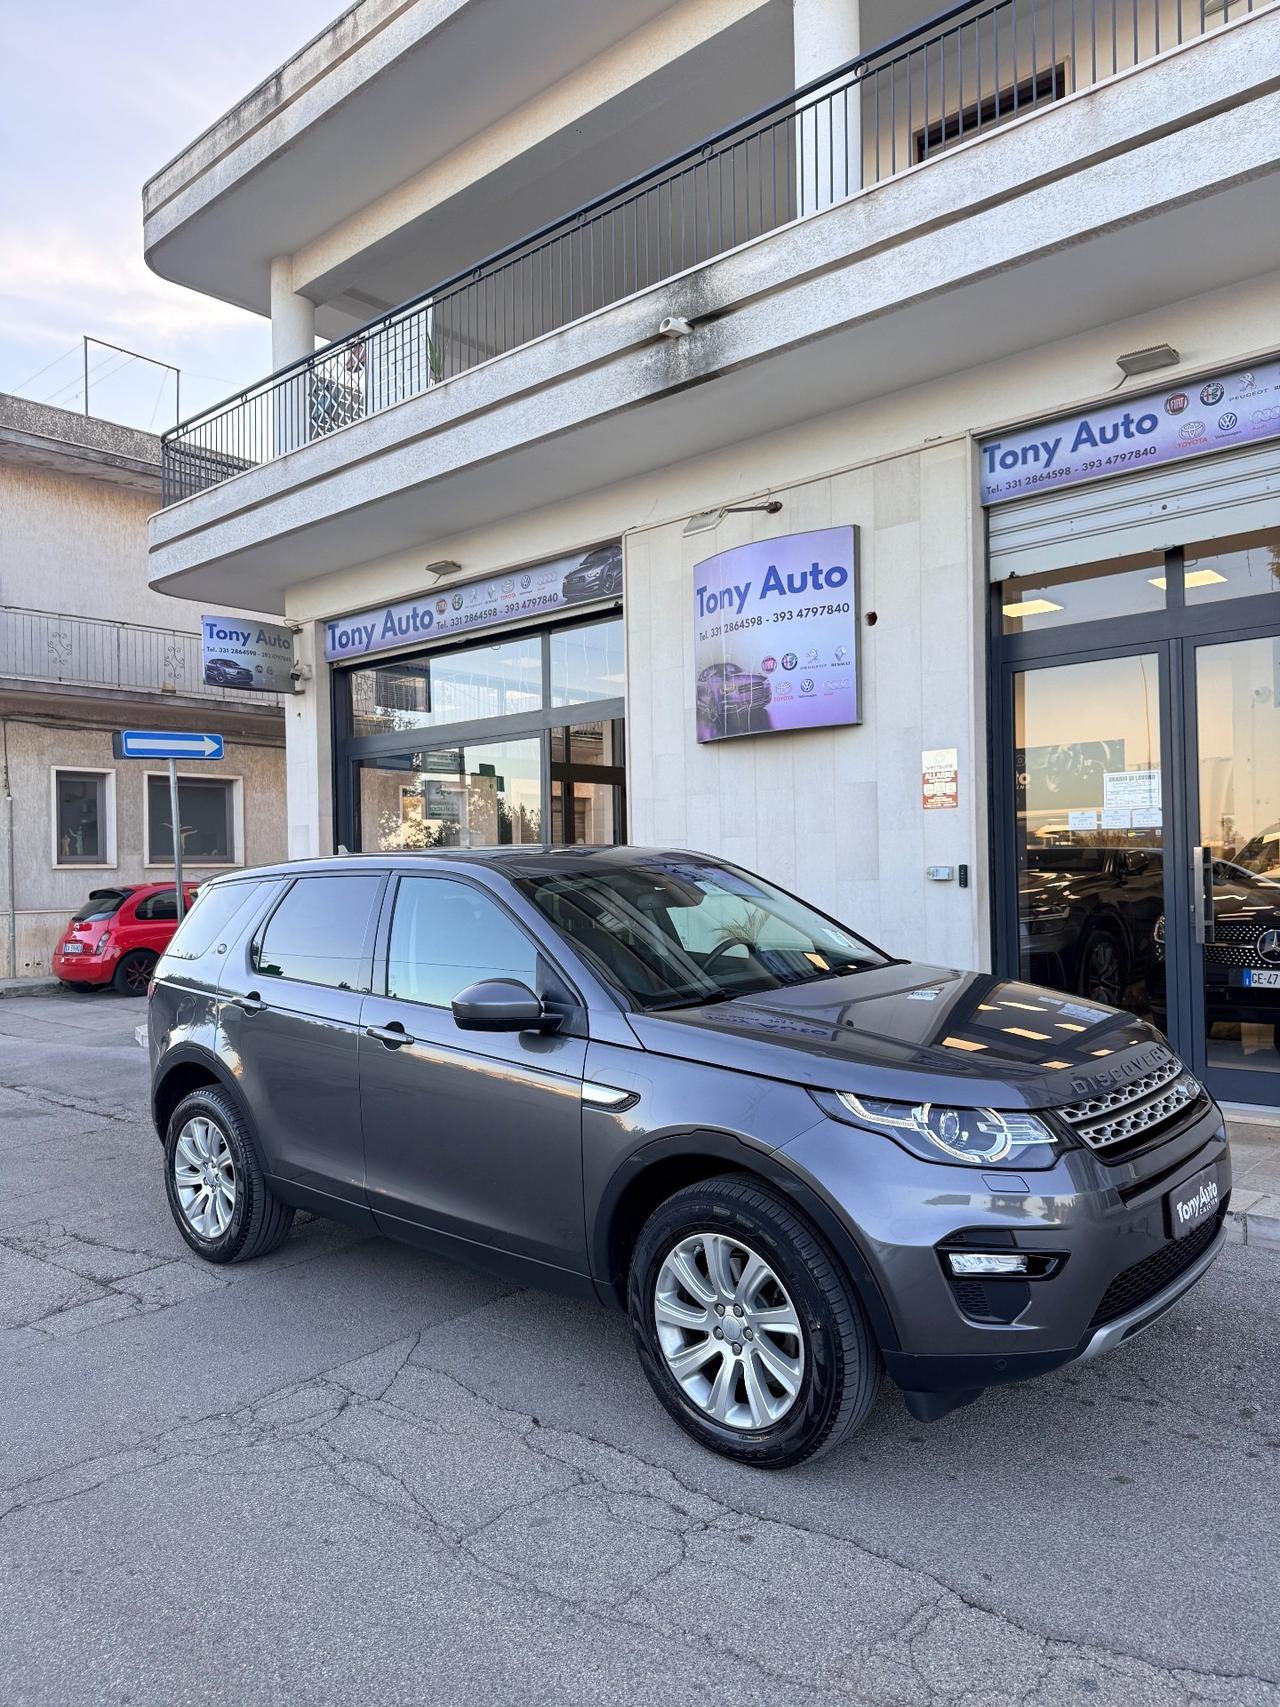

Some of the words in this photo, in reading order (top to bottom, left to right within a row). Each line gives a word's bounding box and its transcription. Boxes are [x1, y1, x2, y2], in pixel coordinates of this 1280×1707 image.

[1228, 388, 1269, 402] PEUGEOT
[983, 436, 1062, 474] Tony
[1071, 411, 1159, 454] Auto
[1177, 437, 1209, 449] TOYOTA
[986, 482, 1003, 495] Tel.
[1005, 479, 1023, 491] 331
[1025, 466, 1072, 487] 2864598
[1081, 459, 1103, 473] 393
[1105, 445, 1158, 467] 4797840
[500, 592, 517, 601] TOYOTA
[696, 581, 753, 618] Tony
[759, 561, 849, 600] Auto
[328, 622, 376, 652] Tony
[380, 606, 434, 640] Auto
[436, 620, 449, 631] Tel.
[450, 617, 463, 628] 331
[464, 607, 498, 624] 2864598
[504, 603, 520, 614] 393
[521, 592, 559, 610] 4797840
[699, 632, 710, 642] Tel.
[710, 626, 723, 638] 331
[724, 615, 763, 634] 2864598
[773, 610, 794, 624] 393
[796, 602, 851, 619] 4797840
[205, 622, 252, 647] Tony
[255, 628, 291, 650] Auto
[230, 648, 257, 657] 2864598
[773, 695, 795, 703] TOYOTA
[1070, 1046, 1170, 1095] DISCOVERY
